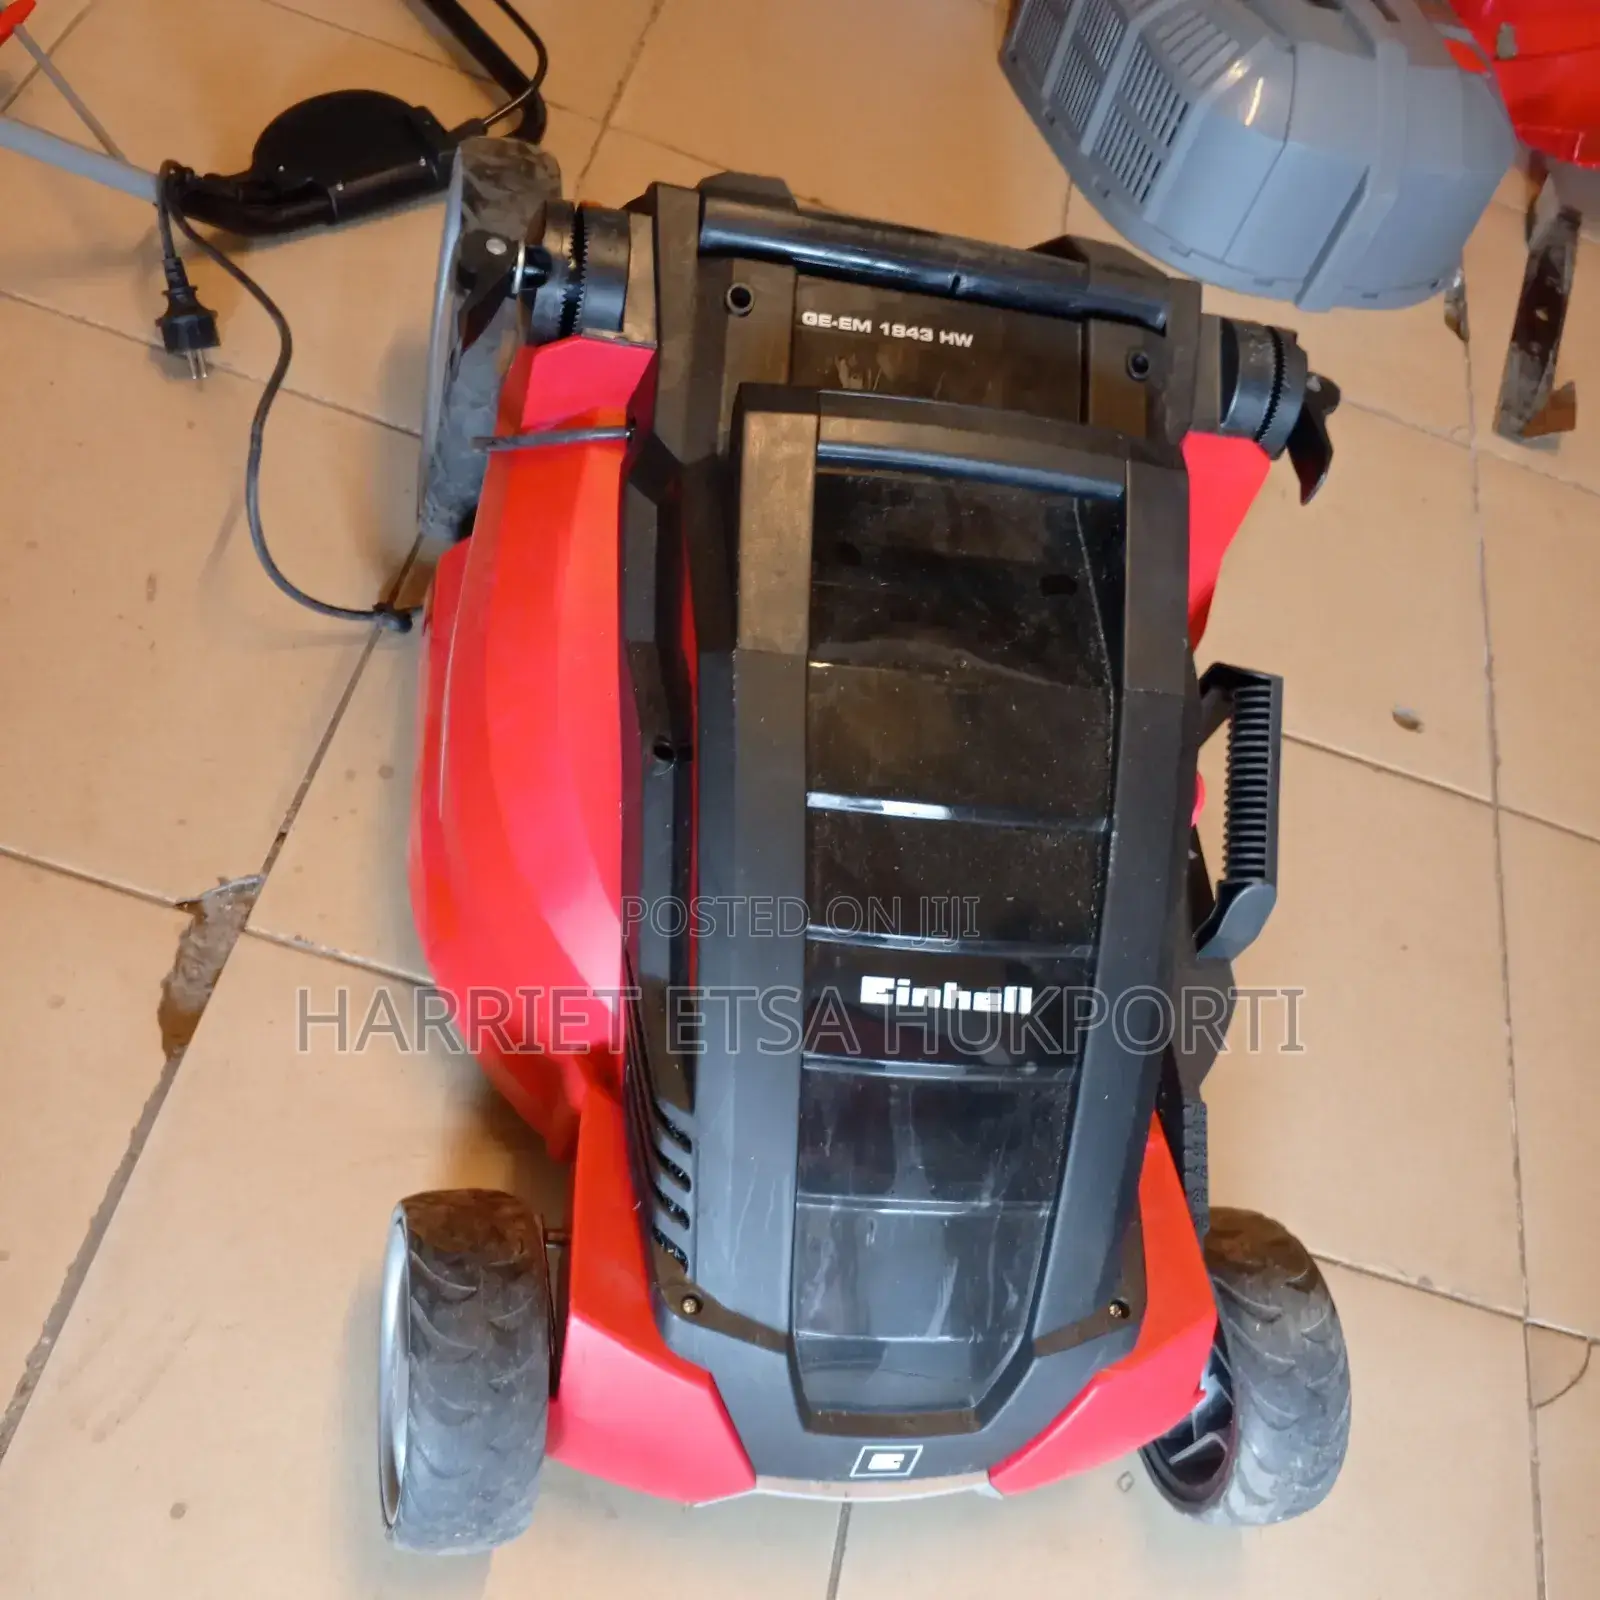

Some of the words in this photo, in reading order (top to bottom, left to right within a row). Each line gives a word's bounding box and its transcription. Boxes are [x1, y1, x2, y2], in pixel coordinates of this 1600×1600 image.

[801, 311, 872, 334] GE-EM
[879, 322, 934, 343] 1843
[939, 330, 974, 348] HW
[860, 975, 1033, 1014] Einhell
